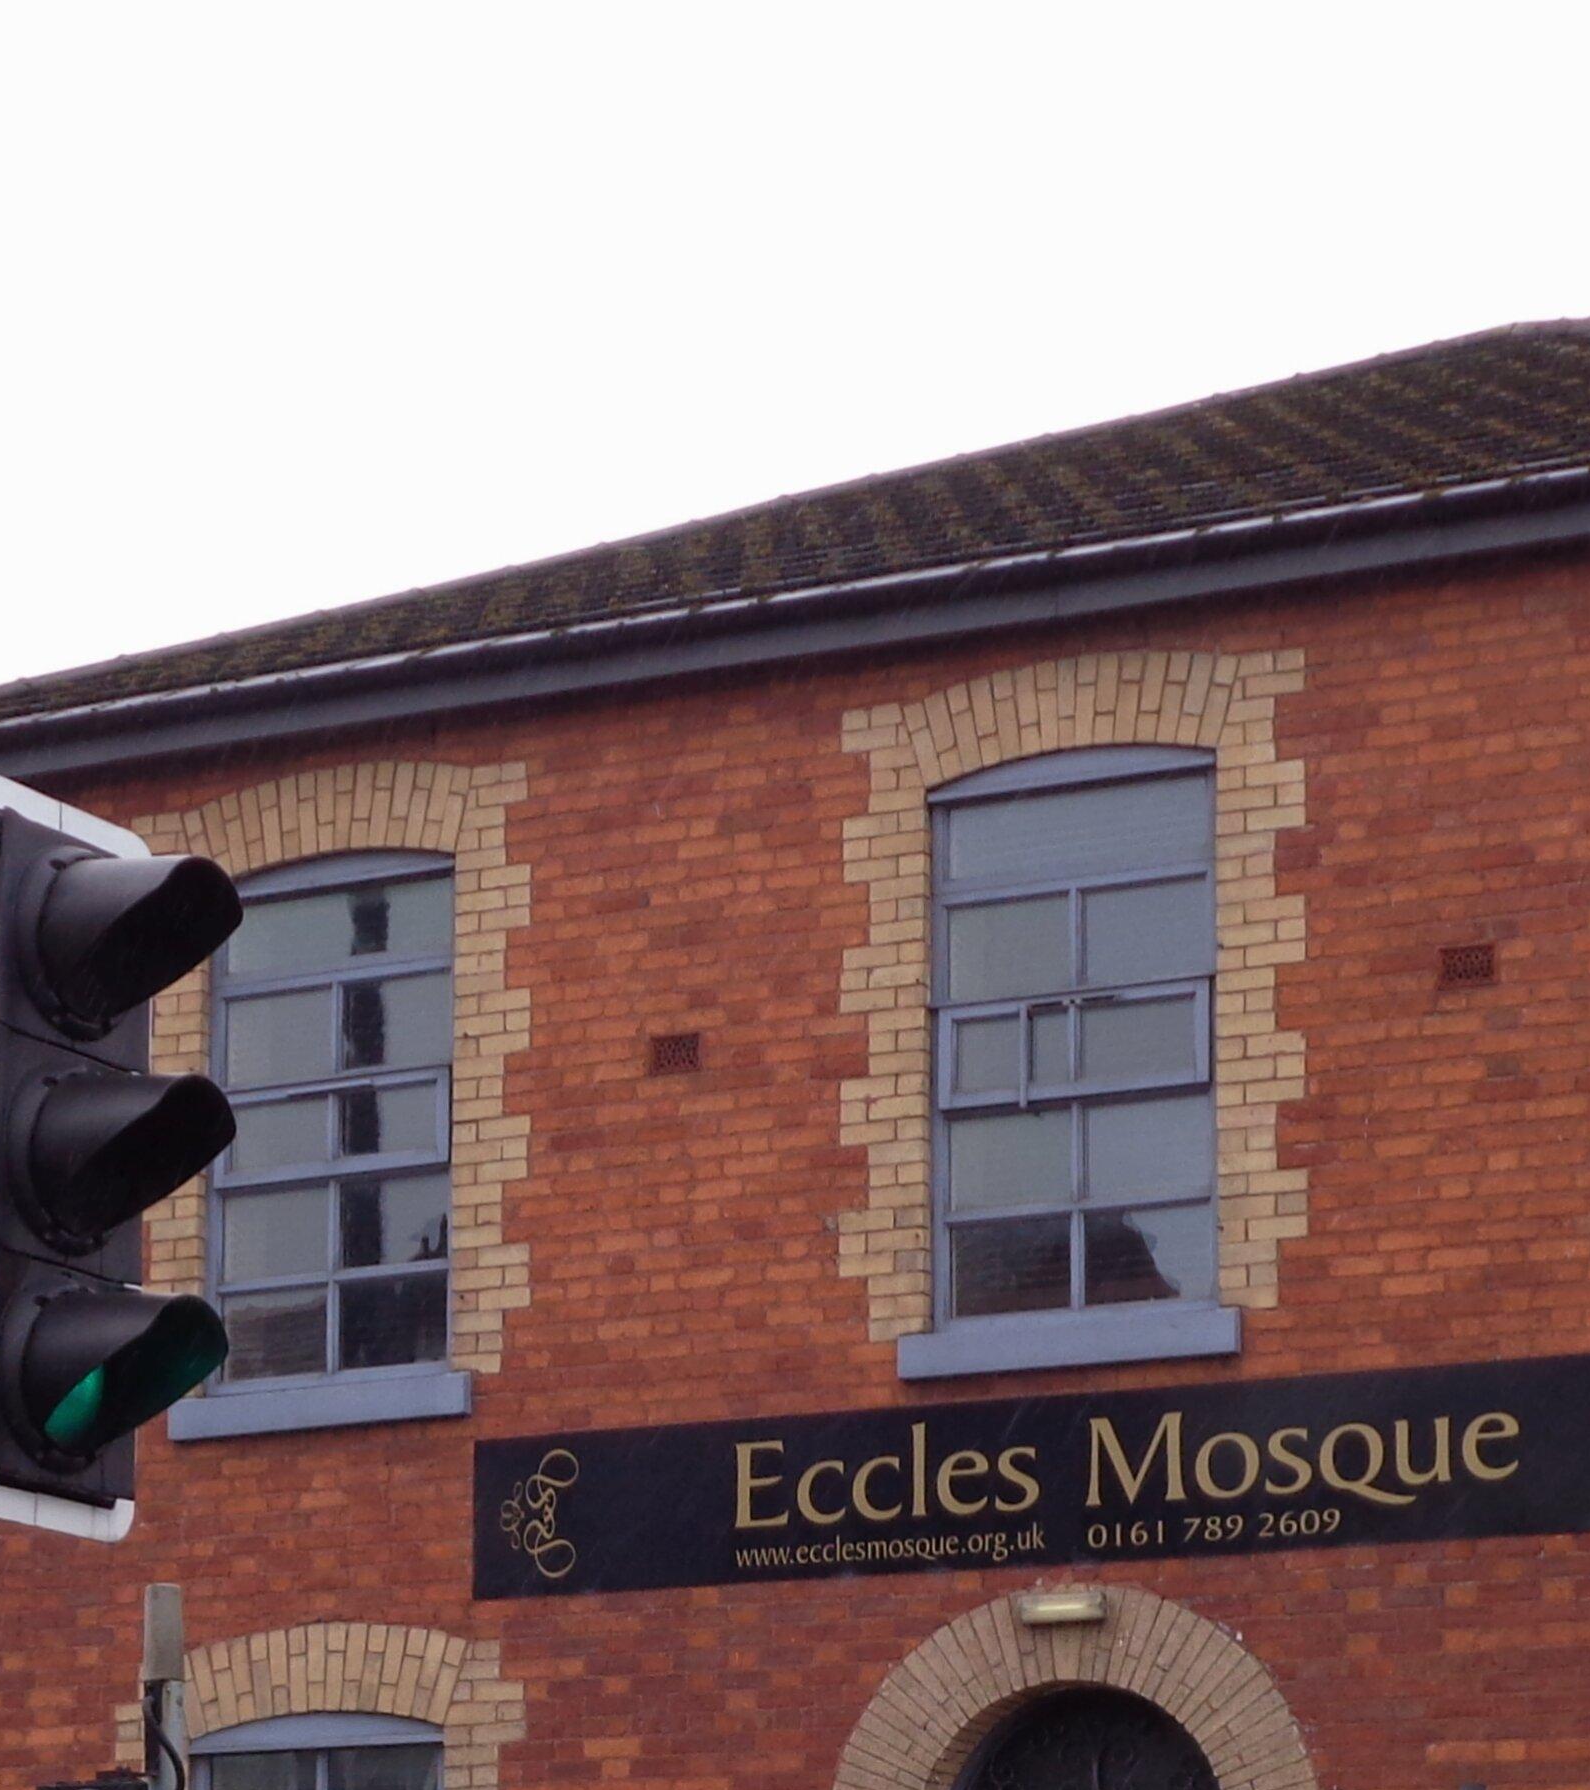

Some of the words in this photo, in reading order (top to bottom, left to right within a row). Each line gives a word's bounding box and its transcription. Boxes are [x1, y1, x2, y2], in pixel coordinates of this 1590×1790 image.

[734, 1421, 1041, 1531] Eccles
[1085, 1409, 1521, 1507] Mosque
[735, 1521, 1046, 1568] www.ecclesmosque.org.uk
[1087, 1520, 1164, 1549] 0161
[1183, 1514, 1244, 1543] 789
[1259, 1508, 1342, 1537] 2609
